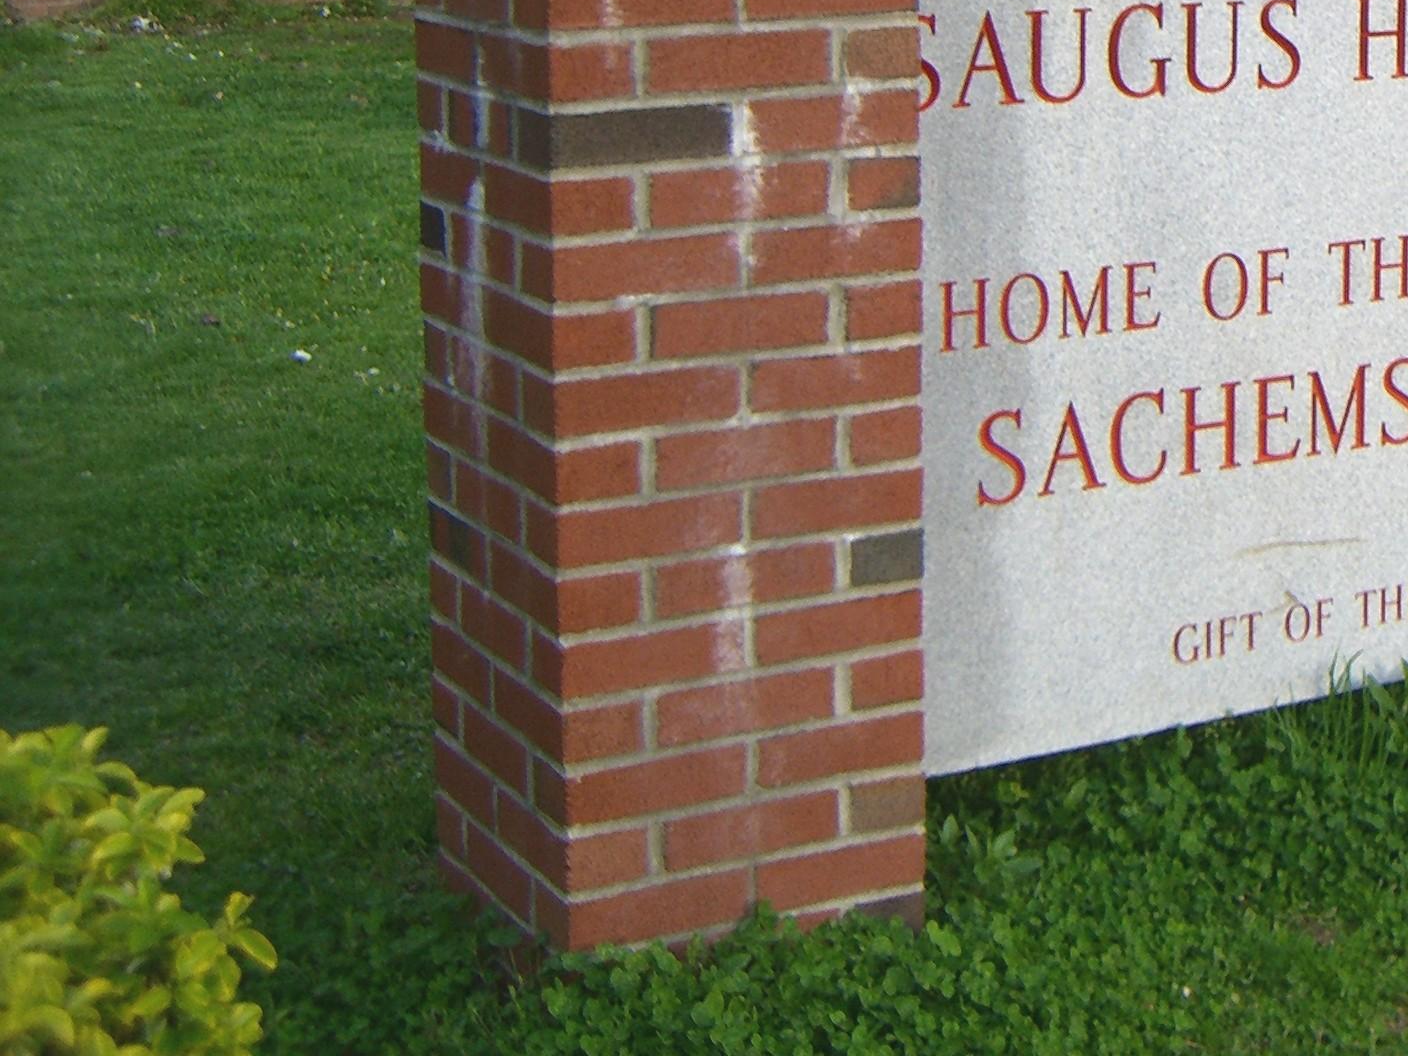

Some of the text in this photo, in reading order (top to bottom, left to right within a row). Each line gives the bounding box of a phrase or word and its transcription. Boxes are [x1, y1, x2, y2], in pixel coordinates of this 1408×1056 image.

[939, 261, 1162, 354] HOME
[1202, 247, 1291, 322] OF
[1172, 610, 1264, 666] GIFT
[1284, 596, 1334, 643] OF
